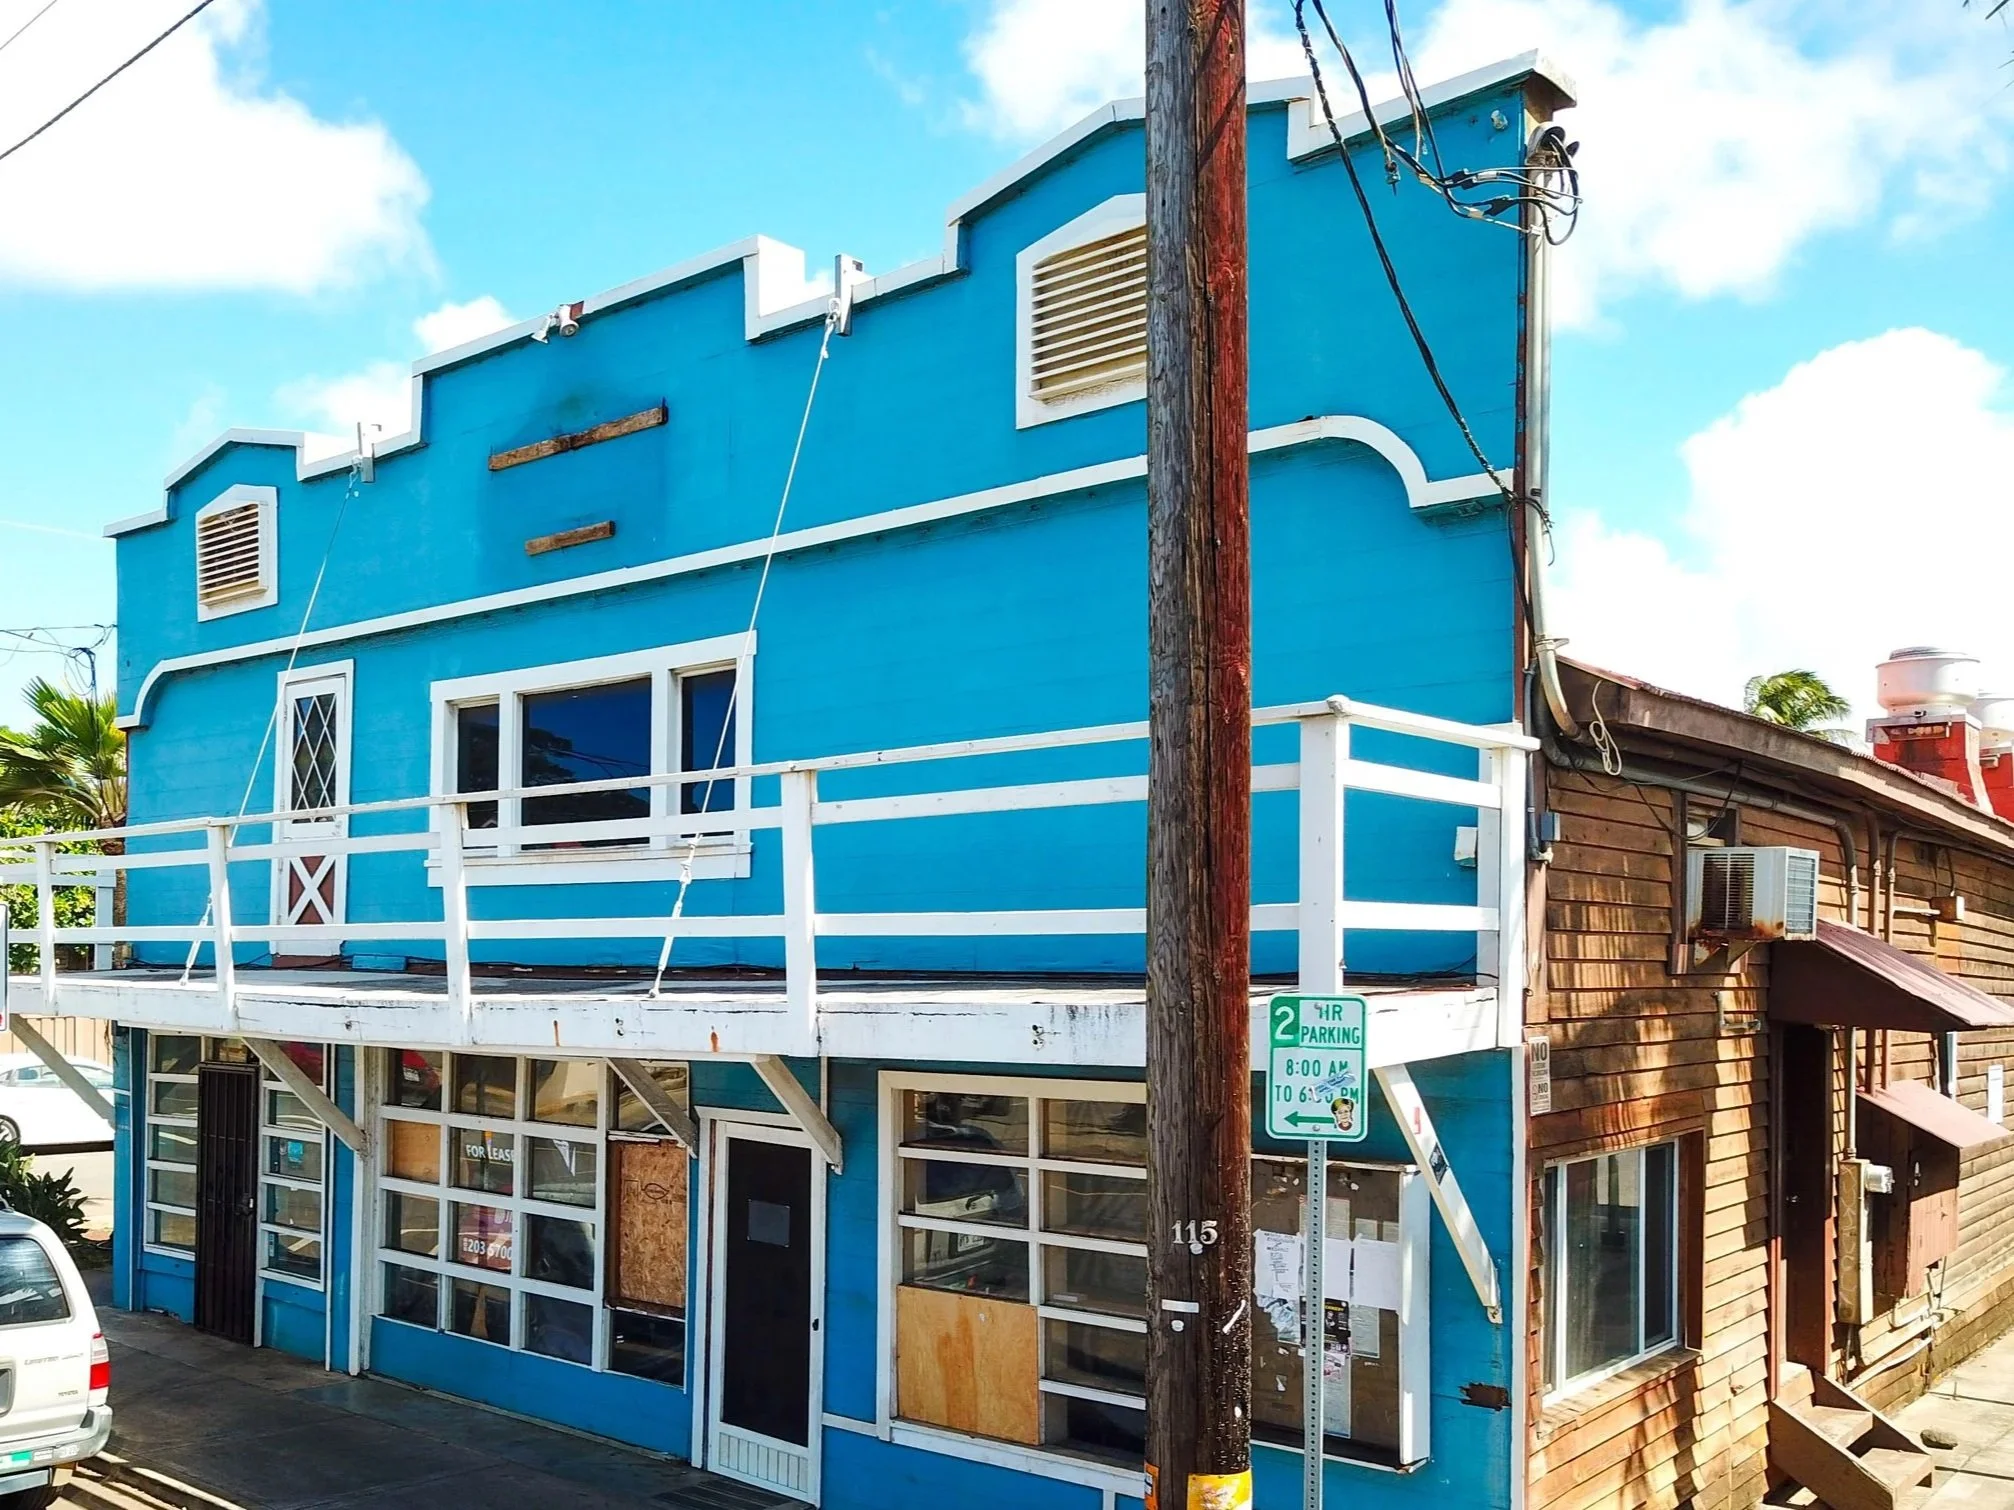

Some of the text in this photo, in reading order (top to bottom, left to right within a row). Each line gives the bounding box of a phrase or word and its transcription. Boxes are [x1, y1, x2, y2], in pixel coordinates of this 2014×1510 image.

[1274, 1004, 1343, 1040] 2 HR
[1301, 1025, 1360, 1045] PARKING
[1531, 1042, 1548, 1061] NO
[1286, 1059, 1321, 1077] 8:00
[1275, 1085, 1292, 1103] TO
[1538, 1082, 1549, 1093] NO
[466, 1144, 486, 1159] FOR
[1171, 1219, 1218, 1245] 115
[468, 1238, 486, 1255] 203
